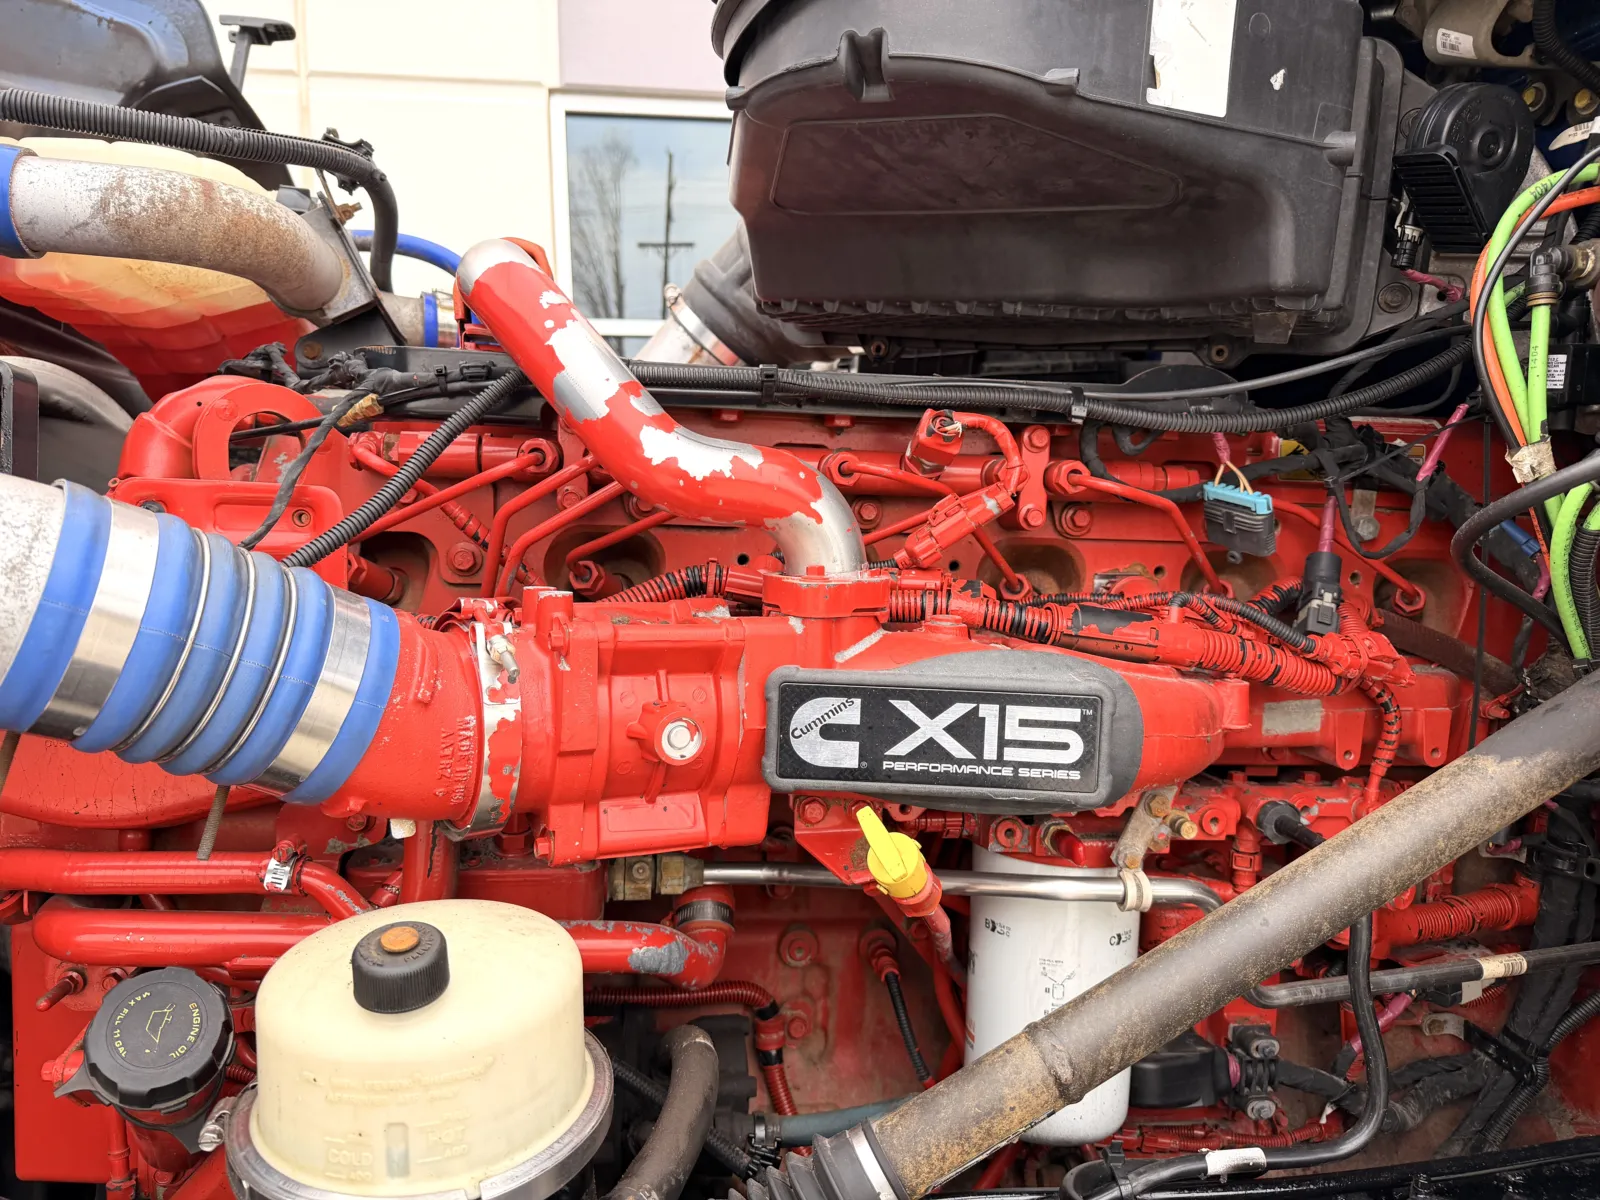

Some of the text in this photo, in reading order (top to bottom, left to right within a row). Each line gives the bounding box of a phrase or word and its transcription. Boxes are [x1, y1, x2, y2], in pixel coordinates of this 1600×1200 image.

[791, 697, 854, 740] Cummins
[884, 700, 1084, 764] X15
[883, 761, 1081, 780] PERFORMANCE SERIES
[113, 992, 150, 1057] MAX FILL 11 GAL
[169, 1002, 200, 1058] ENGINE OIL
[328, 1148, 373, 1166] COLD
